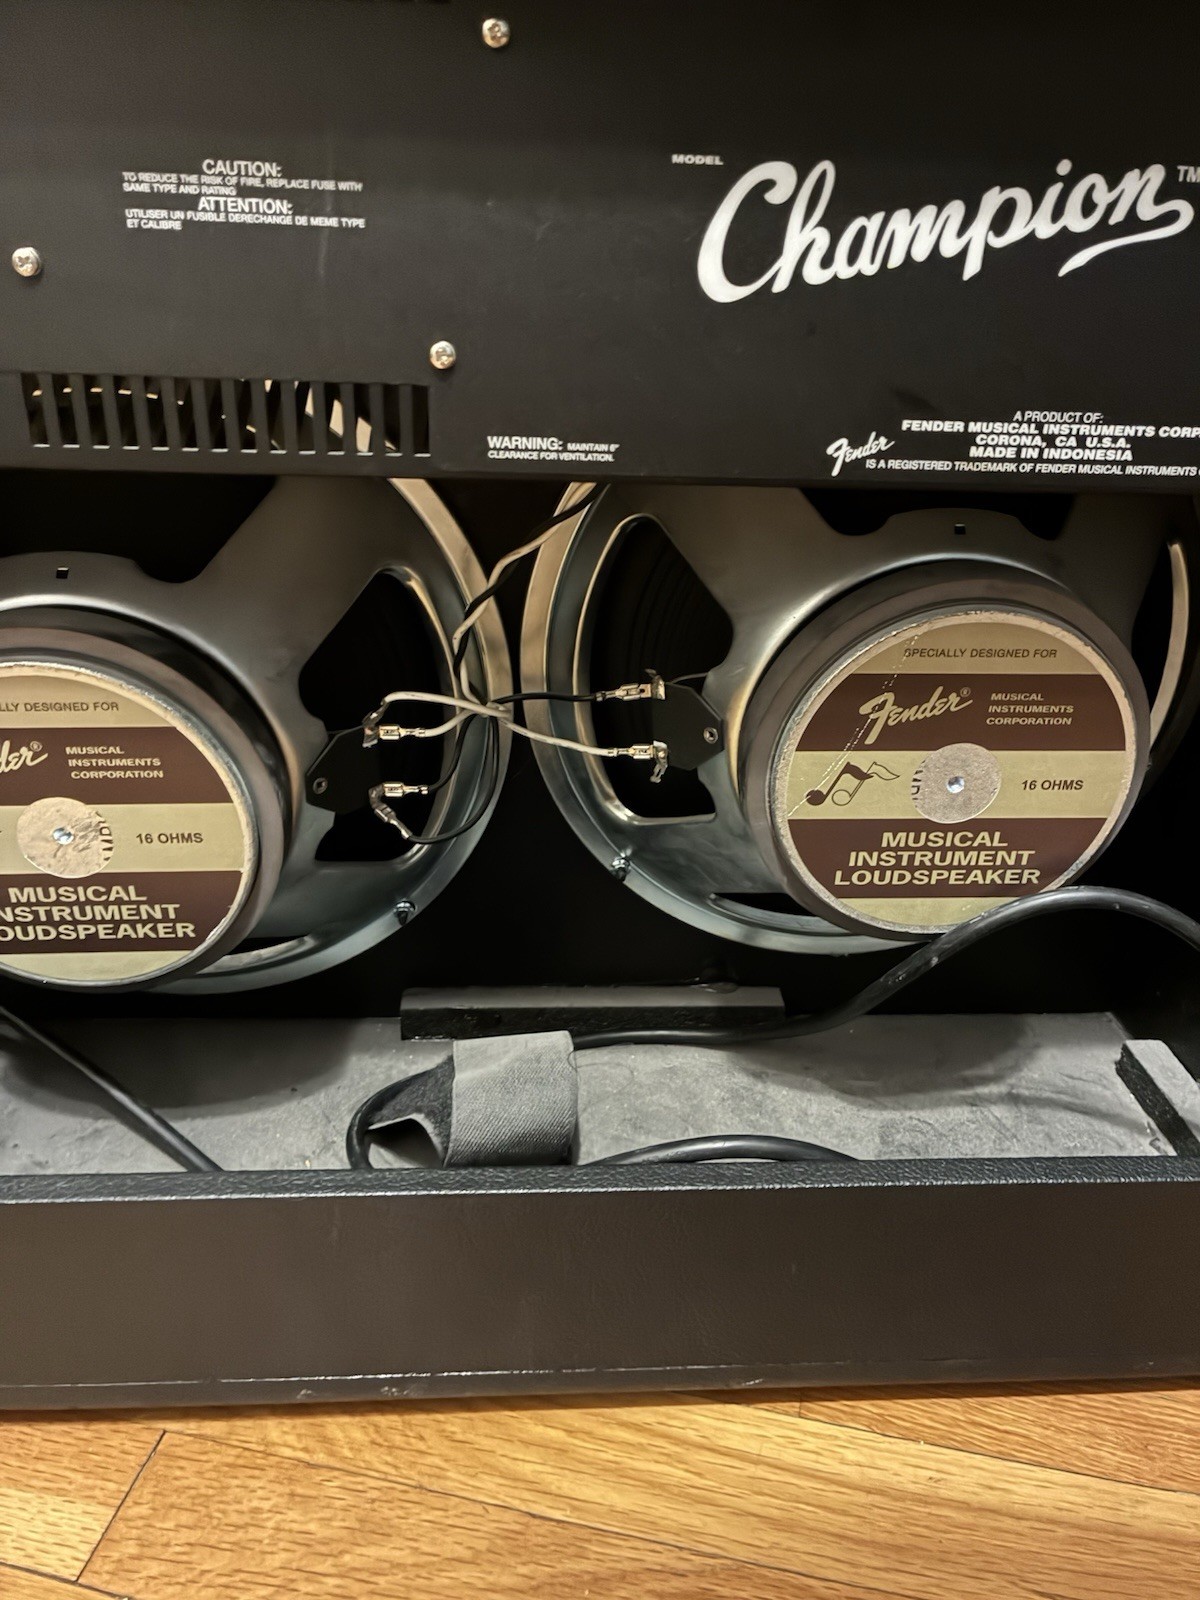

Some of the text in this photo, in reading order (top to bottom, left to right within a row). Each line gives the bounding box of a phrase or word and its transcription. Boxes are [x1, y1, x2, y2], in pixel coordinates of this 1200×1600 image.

[671, 153, 724, 166] MODEL
[202, 158, 283, 178] CAUTION:
[122, 171, 137, 182] TO
[137, 172, 179, 183] REDUCE
[179, 174, 199, 184] THE
[200, 175, 223, 185] RISK
[224, 176, 239, 186] OF
[265, 178, 309, 190] REPLACE
[311, 179, 336, 191] FUSE
[337, 181, 363, 192] WITH
[122, 182, 237, 196] SAME TYPE AND RATING
[197, 196, 293, 215] ATTENTION:
[124, 208, 366, 229] UTILISER UN FUSIBLE DERECHANGE DE MEME TYPE
[126, 219, 183, 230] ET CALIBRE
[697, 159, 1195, 303] Champion
[1012, 411, 1104, 424] A PRODUCT OF:
[901, 419, 965, 433] FENDER
[967, 421, 1039, 435] MUSICAL
[1042, 425, 1155, 438] INSTRUMENTS
[487, 435, 563, 451] WARNING:
[567, 442, 609, 452] MAINTAIN
[975, 434, 1132, 449] CORONA, CA U.S.A.
[487, 450, 615, 462] CLEARANCE FOR VENTILATION.
[826, 430, 896, 477] Fender
[969, 446, 1134, 462] MADE IN INDONESIA
[865, 459, 877, 470] IS
[877, 460, 887, 470] A
[887, 460, 952, 472] REGISTERED
[953, 461, 1018, 473] TRADEMARK
[1018, 463, 1035, 474] OF
[1035, 463, 1077, 475] FENDER
[1077, 464, 1124, 476] MUSICAL
[1125, 465, 1197, 477] INSTRUMENTS
[903, 648, 1058, 660] SPECIALLY DESIGNED FOR
[990, 692, 1045, 702] MUSICAL
[23, 702, 90, 713] DESIGNED
[92, 701, 119, 712] FOR
[987, 704, 1075, 715] INSTRUMENTS
[985, 717, 1073, 727] CORPORATION
[65, 746, 125, 756] MUSICAL
[67, 757, 162, 768] INSTRUMENTS
[70, 770, 164, 781] CORPORATION
[1021, 779, 1085, 792] 16 OHMS
[135, 831, 205, 845] 16 OHMS
[880, 831, 1009, 848] MUSICAL
[848, 850, 1036, 868] INSTRUMENT
[833, 869, 1042, 886] LOUDSPEAKER
[7, 885, 148, 904] MUSICAL
